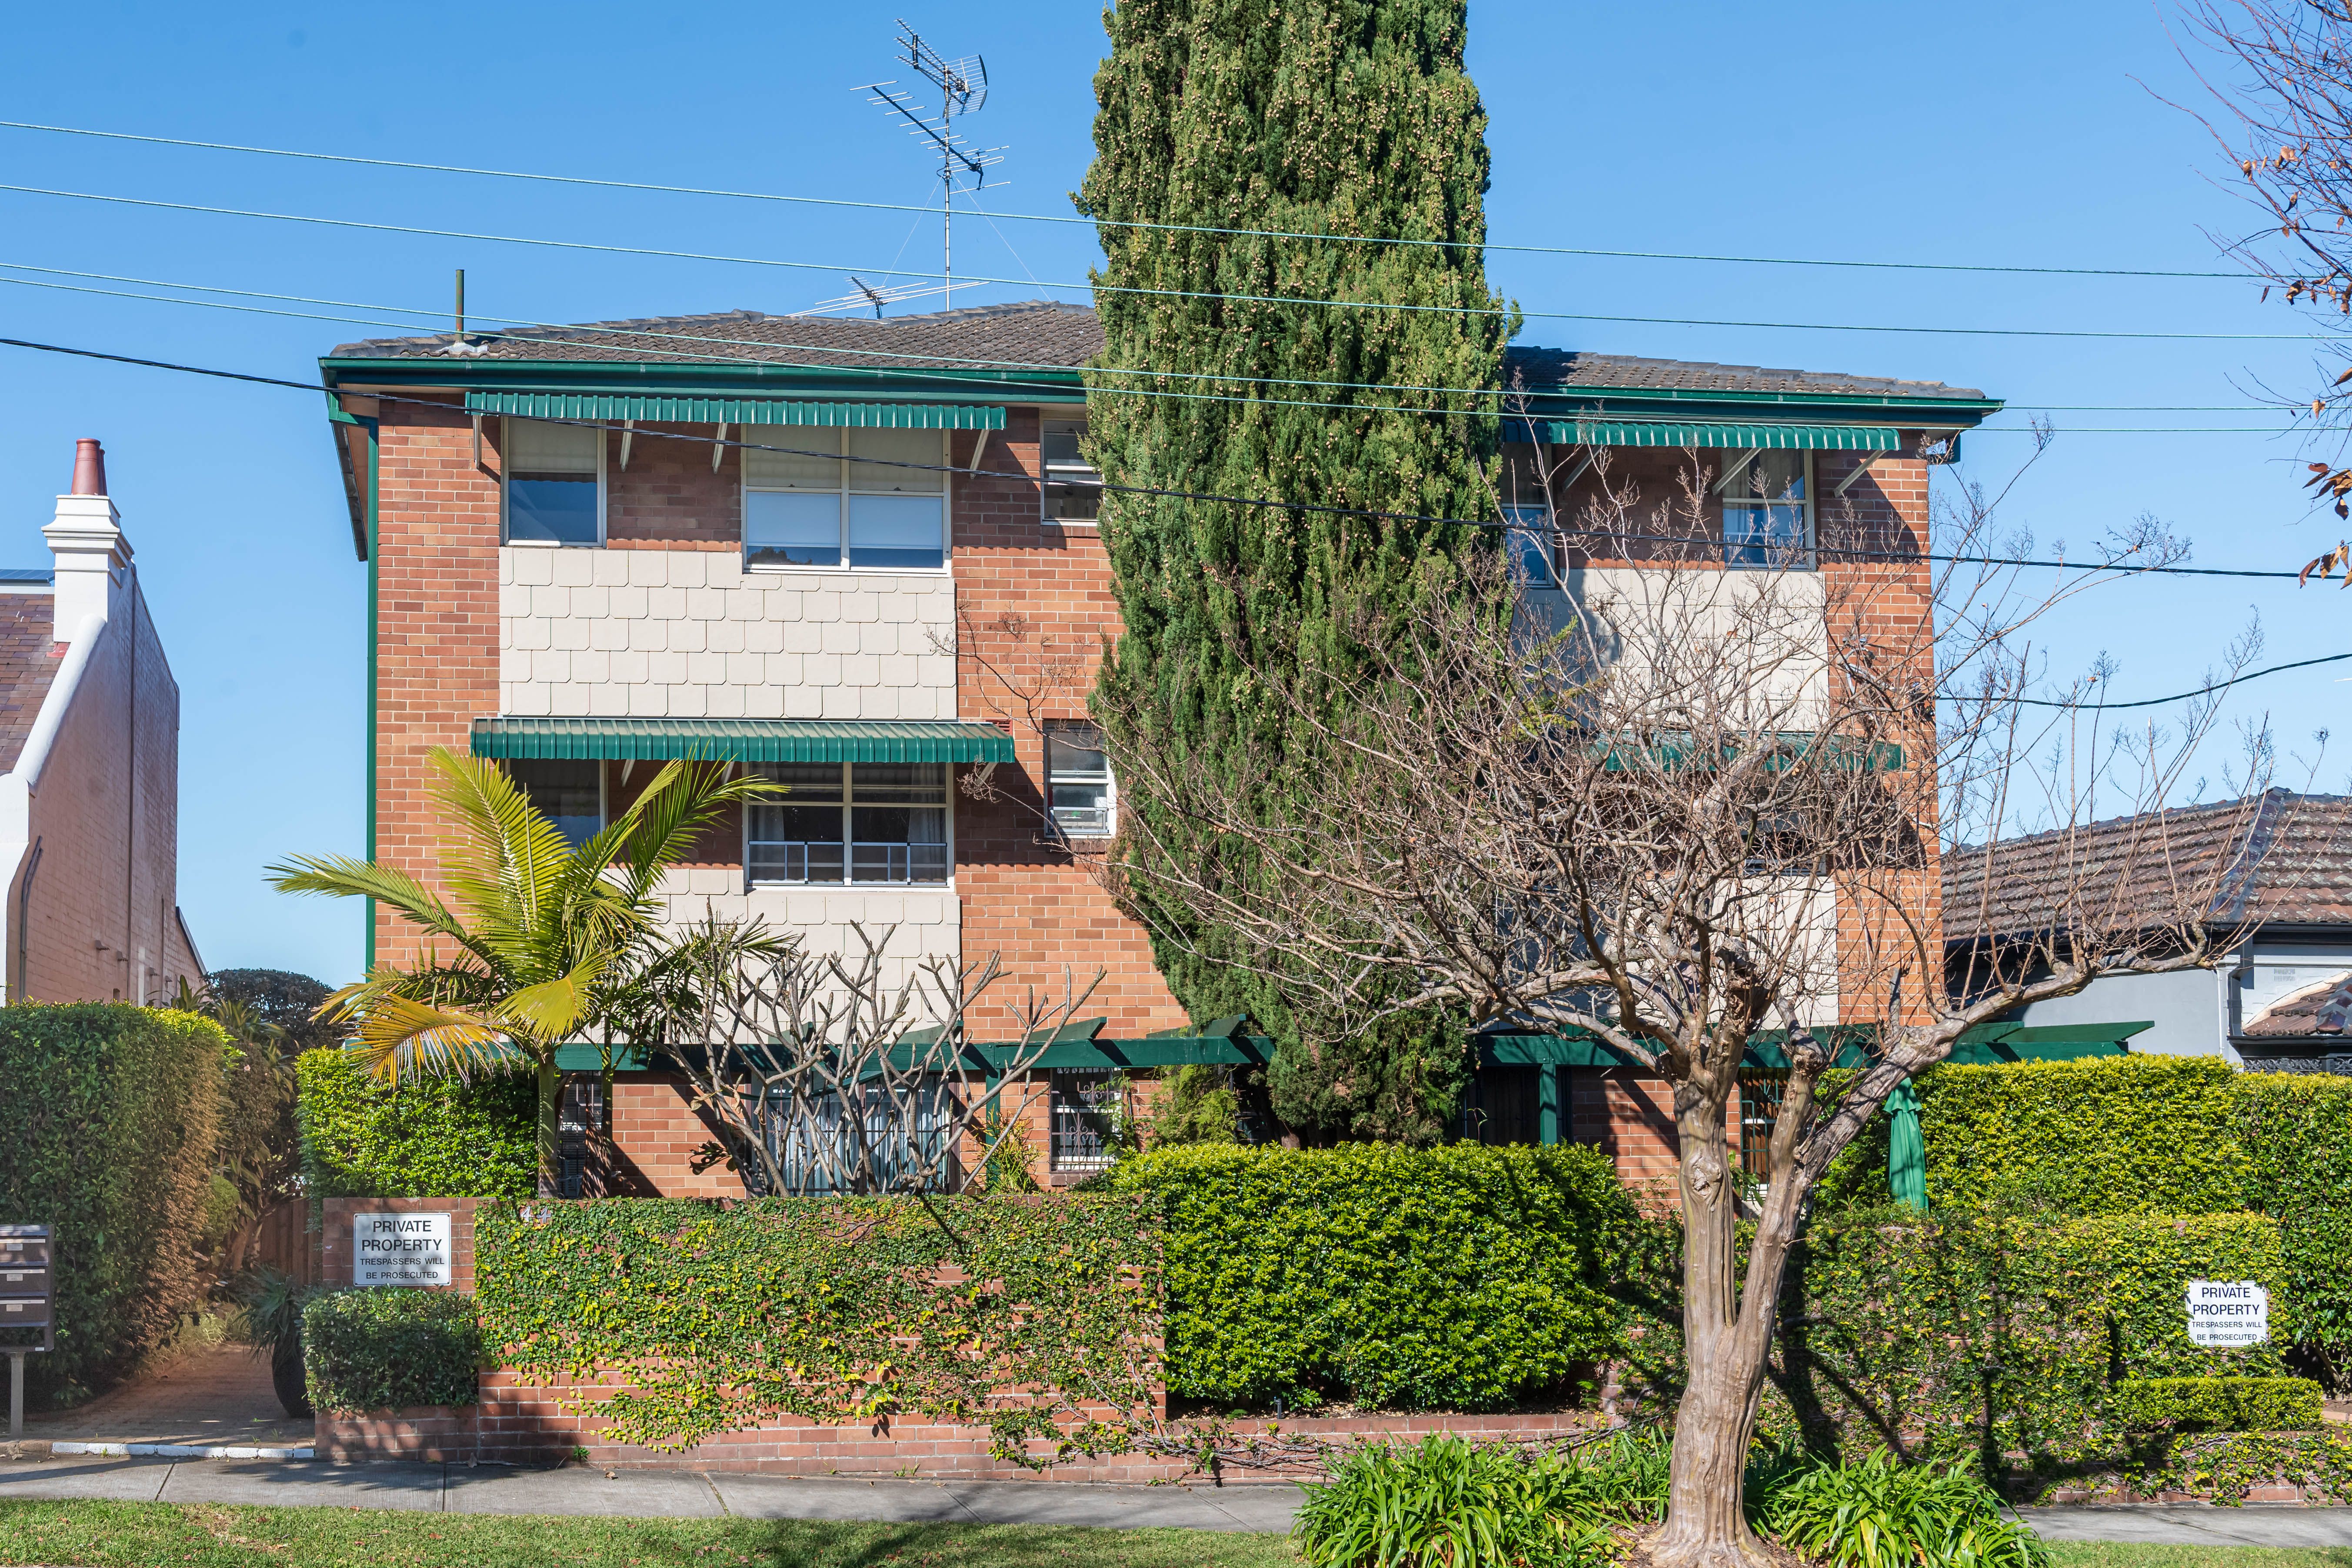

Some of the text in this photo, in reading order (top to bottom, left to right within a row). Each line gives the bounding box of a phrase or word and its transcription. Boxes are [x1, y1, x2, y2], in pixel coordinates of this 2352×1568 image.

[520, 1205, 551, 1224] 44
[373, 1220, 432, 1232] PRIVATE
[361, 1239, 442, 1251] PROPERTY
[2202, 1287, 2251, 1298] PRIVATE
[2193, 1304, 2260, 1315] PROPERTY
